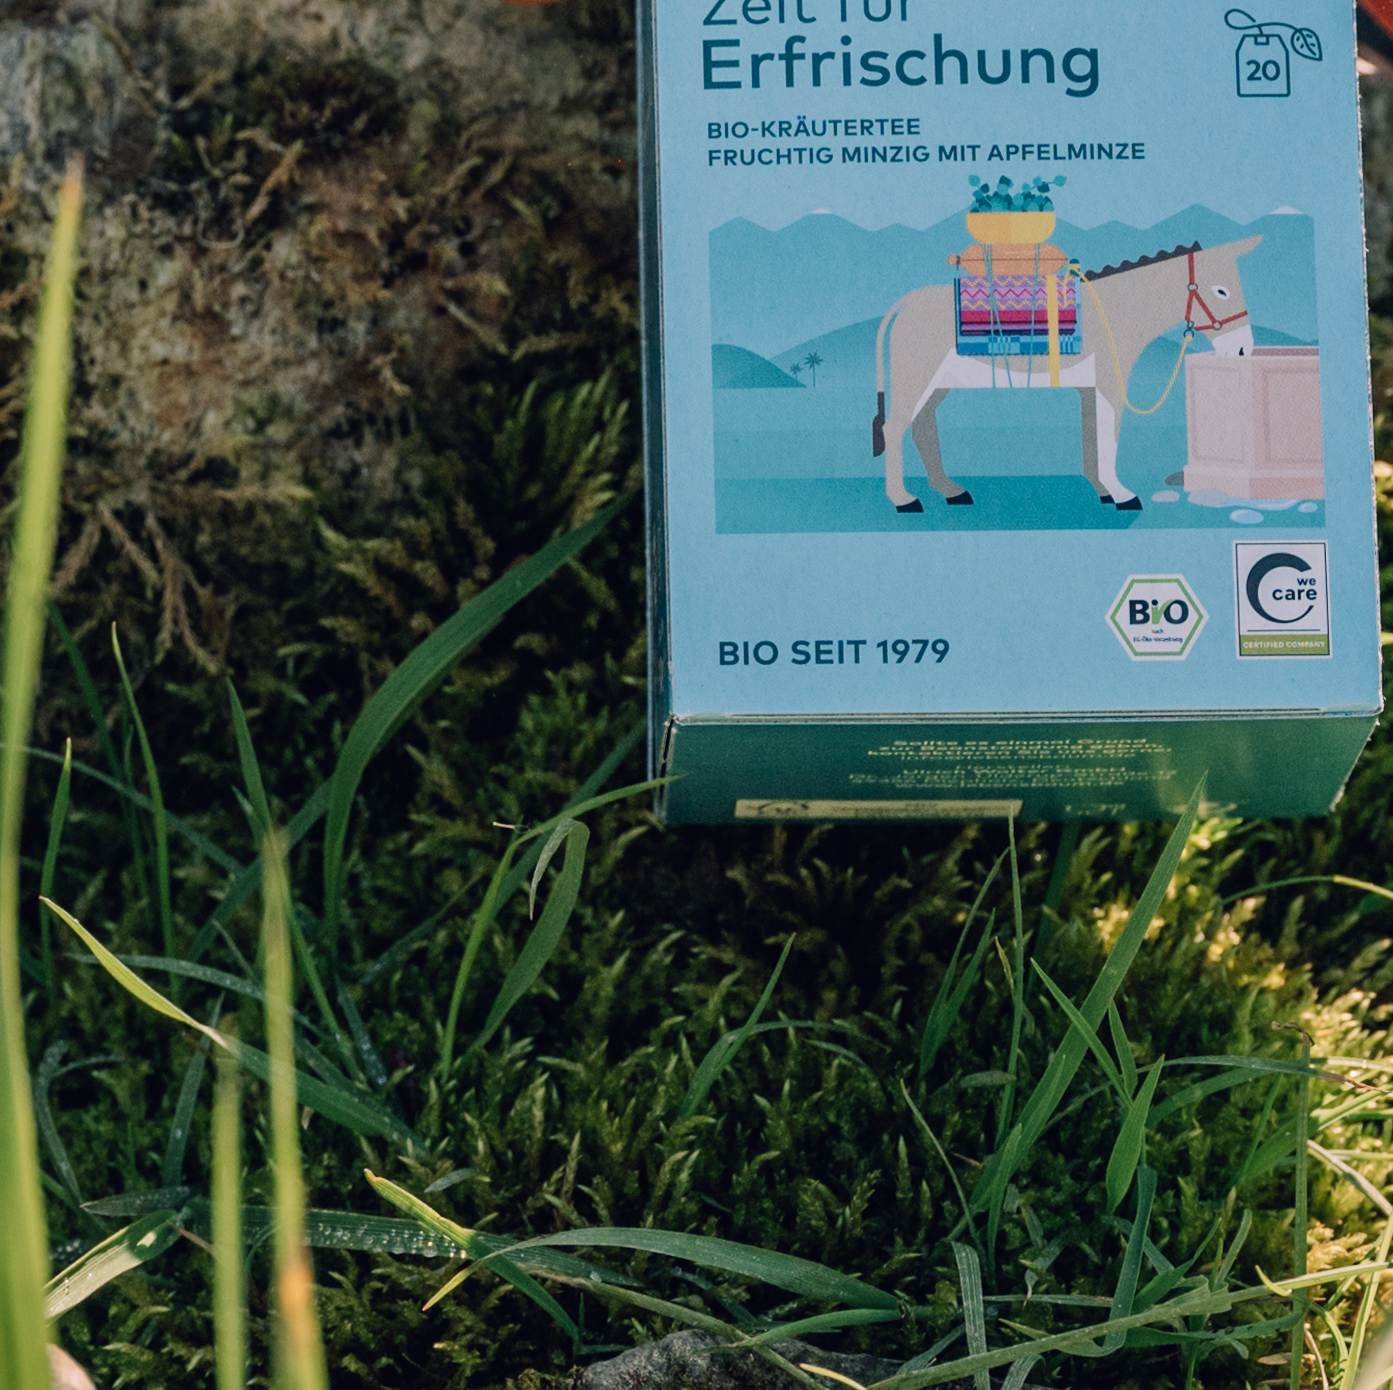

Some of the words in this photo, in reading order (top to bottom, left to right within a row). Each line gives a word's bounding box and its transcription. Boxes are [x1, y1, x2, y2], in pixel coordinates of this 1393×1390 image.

[702, 33, 1099, 98] Erfrischung
[1245, 59, 1281, 82] 20
[707, 115, 921, 140] BIO-KRÄUTERTEE
[708, 147, 834, 167] FRUCHTIG
[841, 145, 930, 165] MINZIG
[938, 144, 980, 162] MIT
[987, 141, 1146, 162] APFELMINZE
[1296, 577, 1317, 586] we
[1272, 588, 1318, 601] care
[719, 640, 779, 666] BIO
[791, 639, 867, 665] SEIT
[876, 638, 950, 664] 1979
